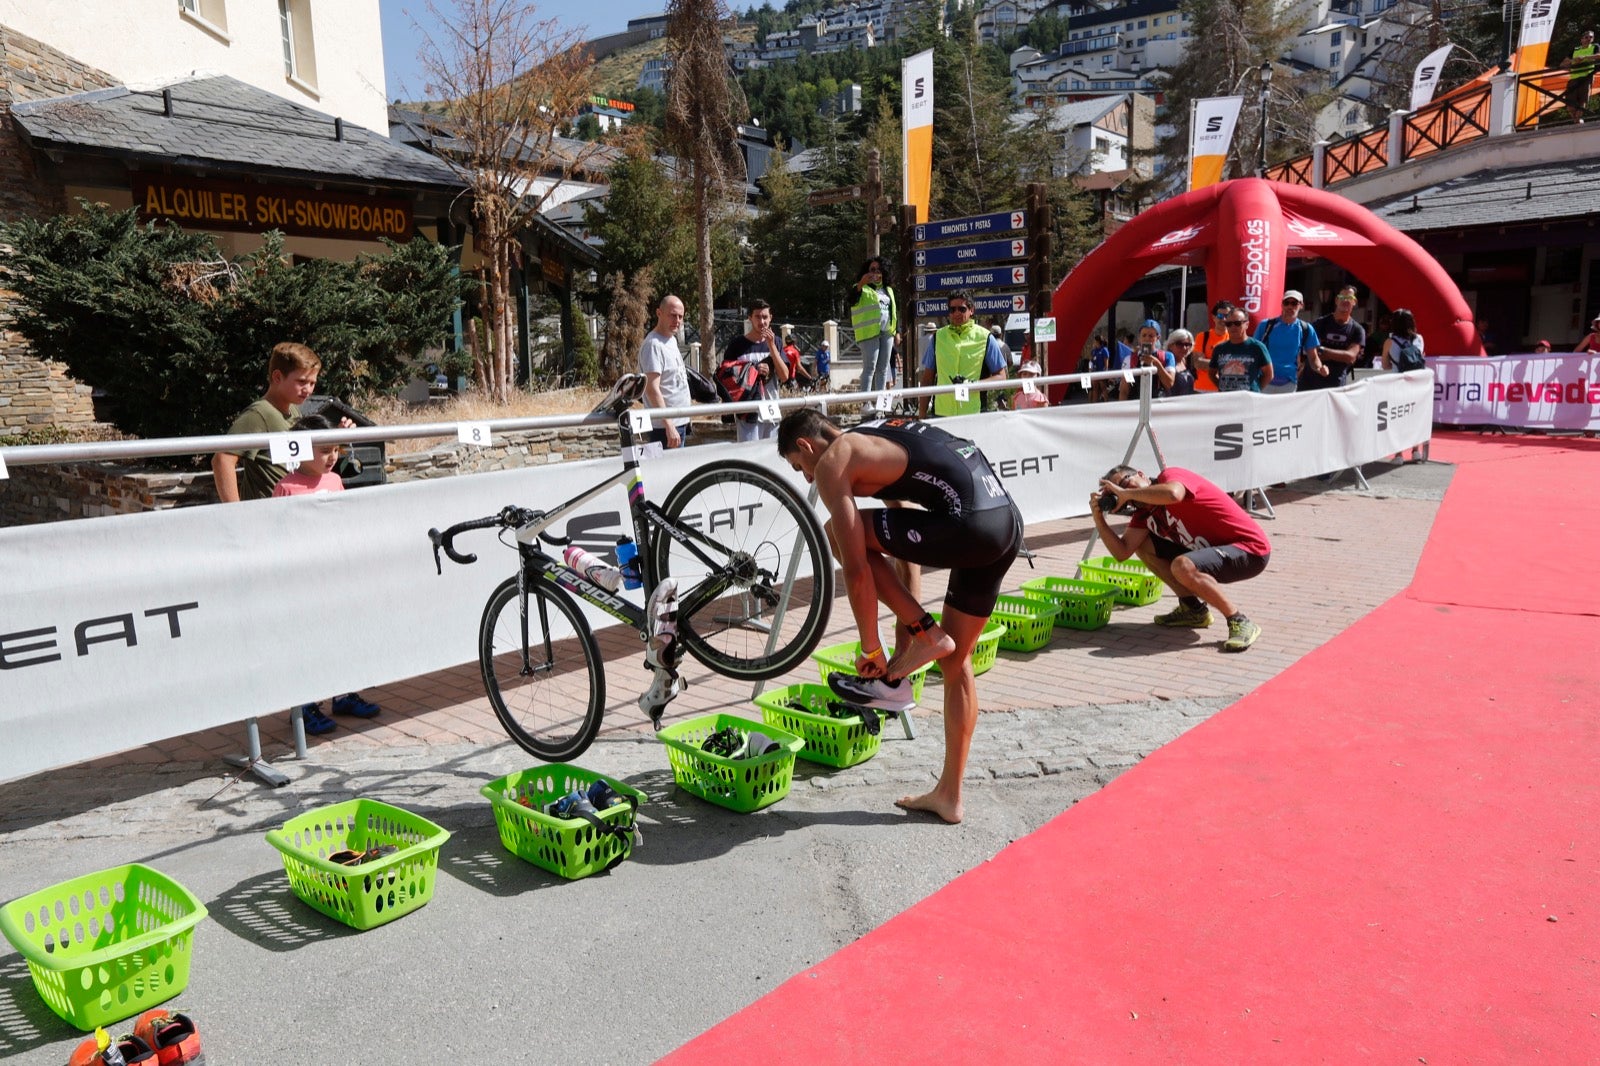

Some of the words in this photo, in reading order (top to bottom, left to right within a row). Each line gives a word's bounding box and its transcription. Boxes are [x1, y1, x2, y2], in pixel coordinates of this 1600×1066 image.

[147, 185, 248, 222] ALQUILER
[256, 196, 405, 234] SKI-SNOWBOARD
[941, 223, 967, 234] REMONTES
[975, 219, 991, 229] PISTAS
[957, 248, 977, 258] CLINICA
[940, 276, 963, 286] PARKING
[965, 274, 993, 284] AUTOBUSES
[926, 303, 939, 312] ZONA
[768, 405, 774, 415] 6
[1390, 402, 1416, 420] SEAT
[636, 417, 642, 429] 7
[472, 428, 481, 441] 8
[1252, 424, 1302, 446] SEAT
[288, 441, 299, 456] 9
[639, 448, 644, 456] 7
[645, 508, 689, 542] MERIDA
[543, 562, 625, 610] MERIDA
[581, 593, 634, 625] MERIDA
